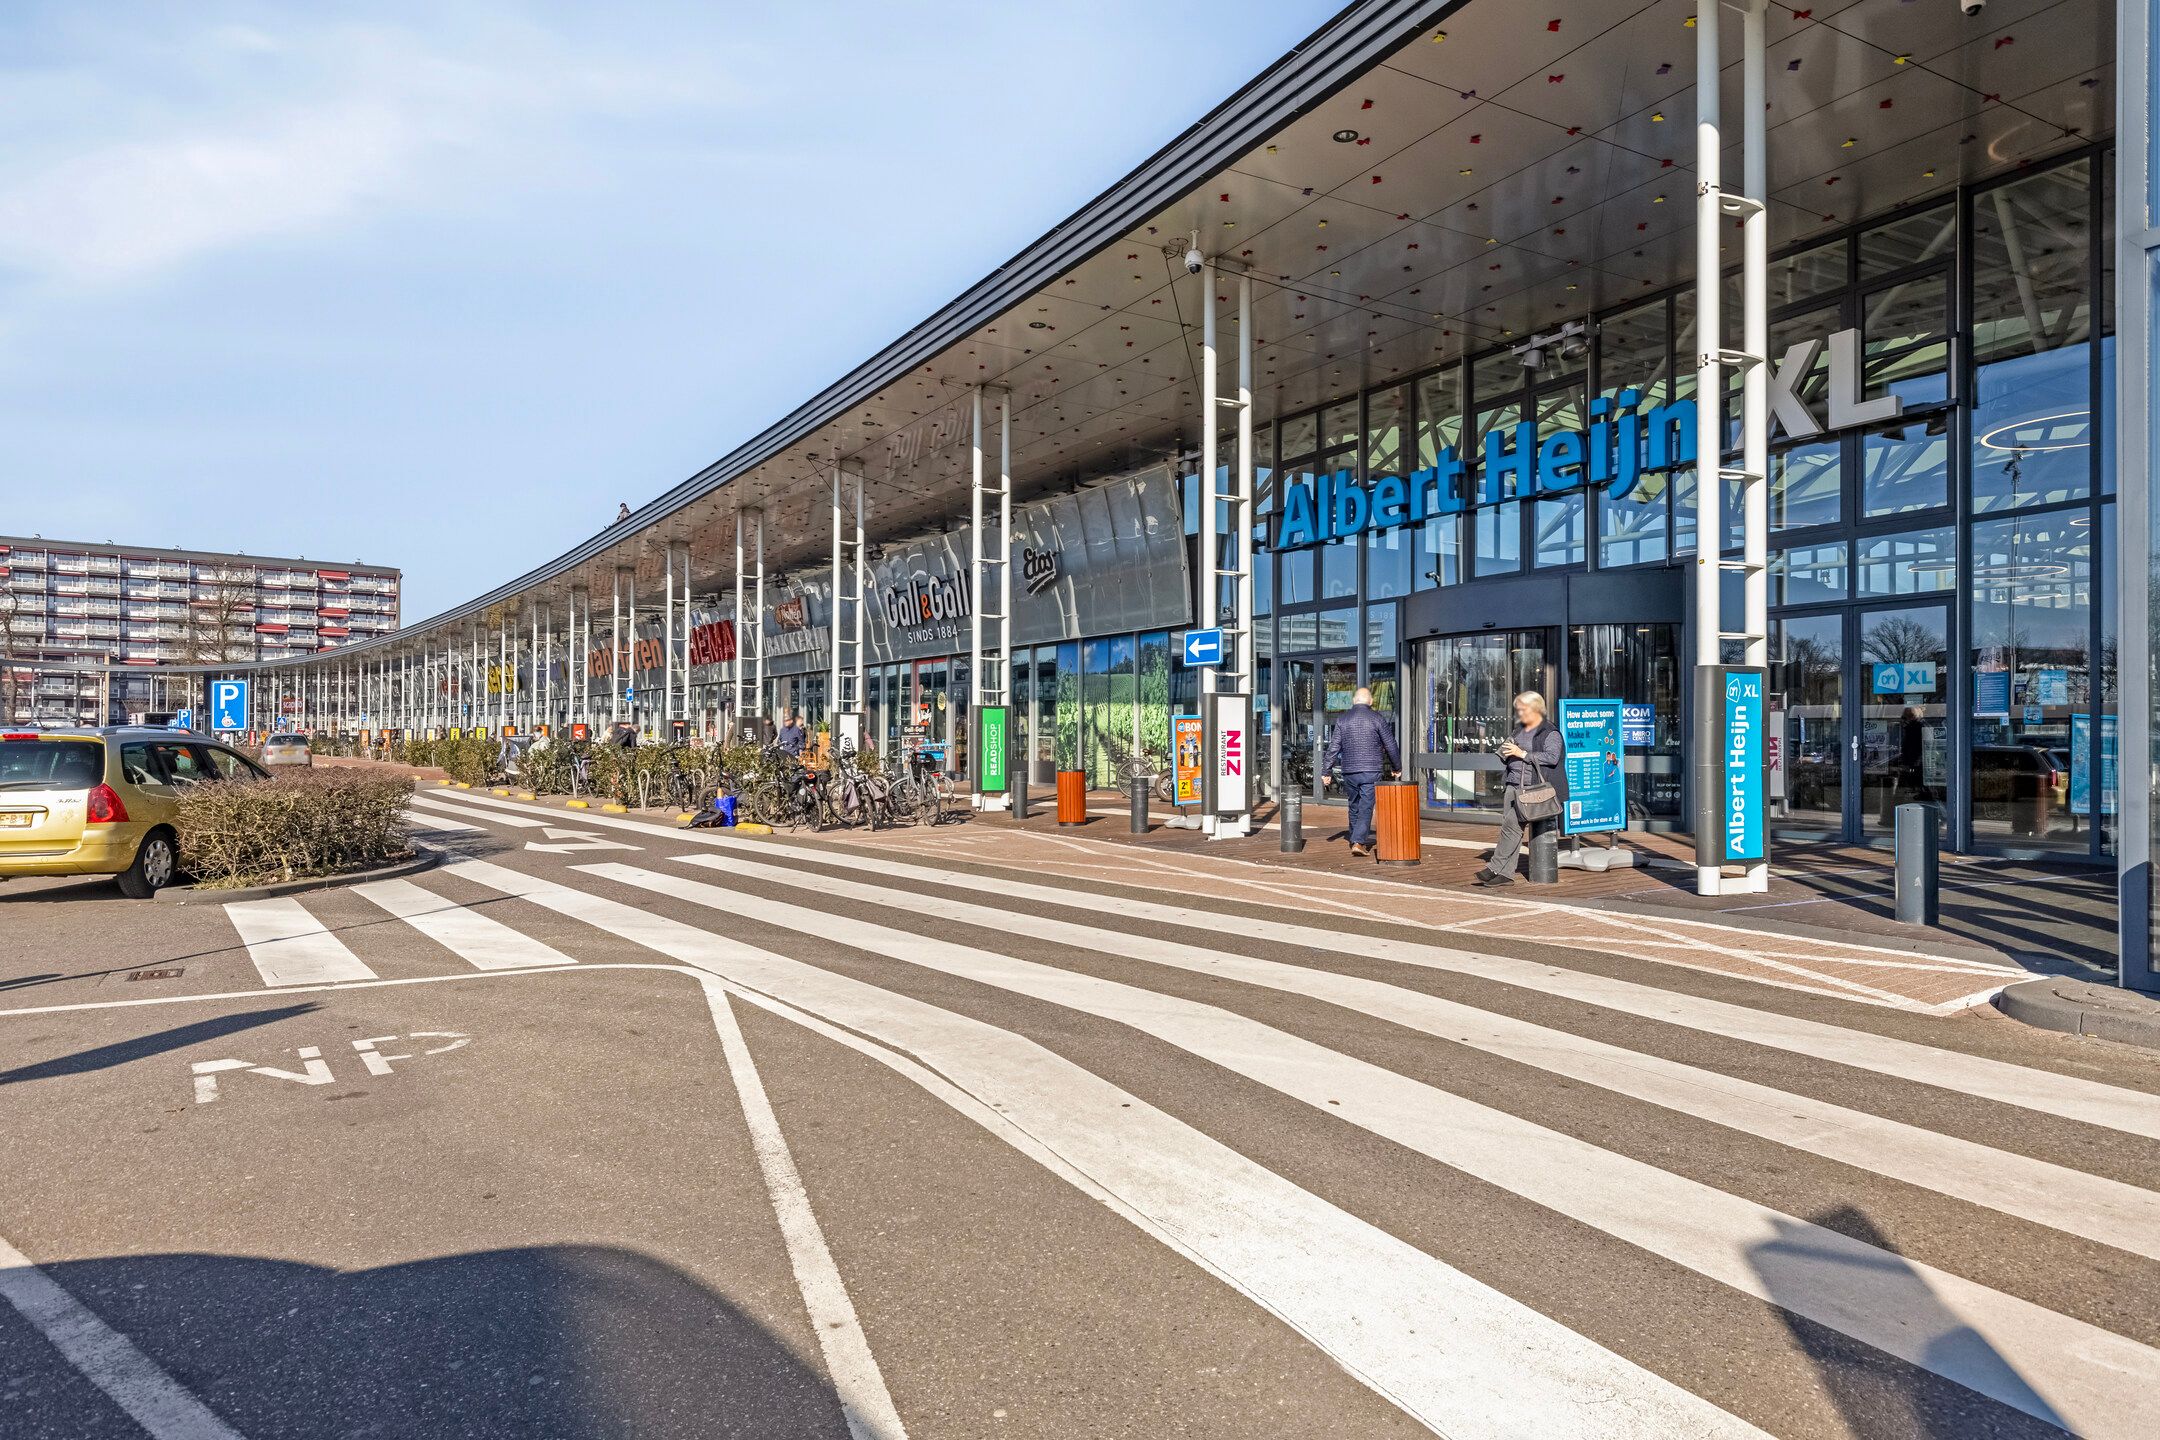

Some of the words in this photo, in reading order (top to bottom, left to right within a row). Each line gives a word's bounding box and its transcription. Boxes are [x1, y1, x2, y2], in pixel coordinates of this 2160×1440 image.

[1279, 444, 1465, 549] Albert
[1486, 388, 1698, 502] Heijn
[1023, 547, 1055, 580] Etos
[908, 628, 934, 644] SINDS
[937, 624, 958, 639] 1884
[1907, 668, 1934, 685] XL
[220, 685, 239, 710] P
[1743, 684, 1759, 698] XL
[180, 711, 189, 721] P
[1581, 710, 1598, 718] about
[1584, 719, 1606, 729] money?
[1730, 705, 1749, 768] Heijn
[990, 723, 998, 776] READSHOP
[1227, 730, 1241, 775] ZIN
[1729, 773, 1746, 854] Albert
